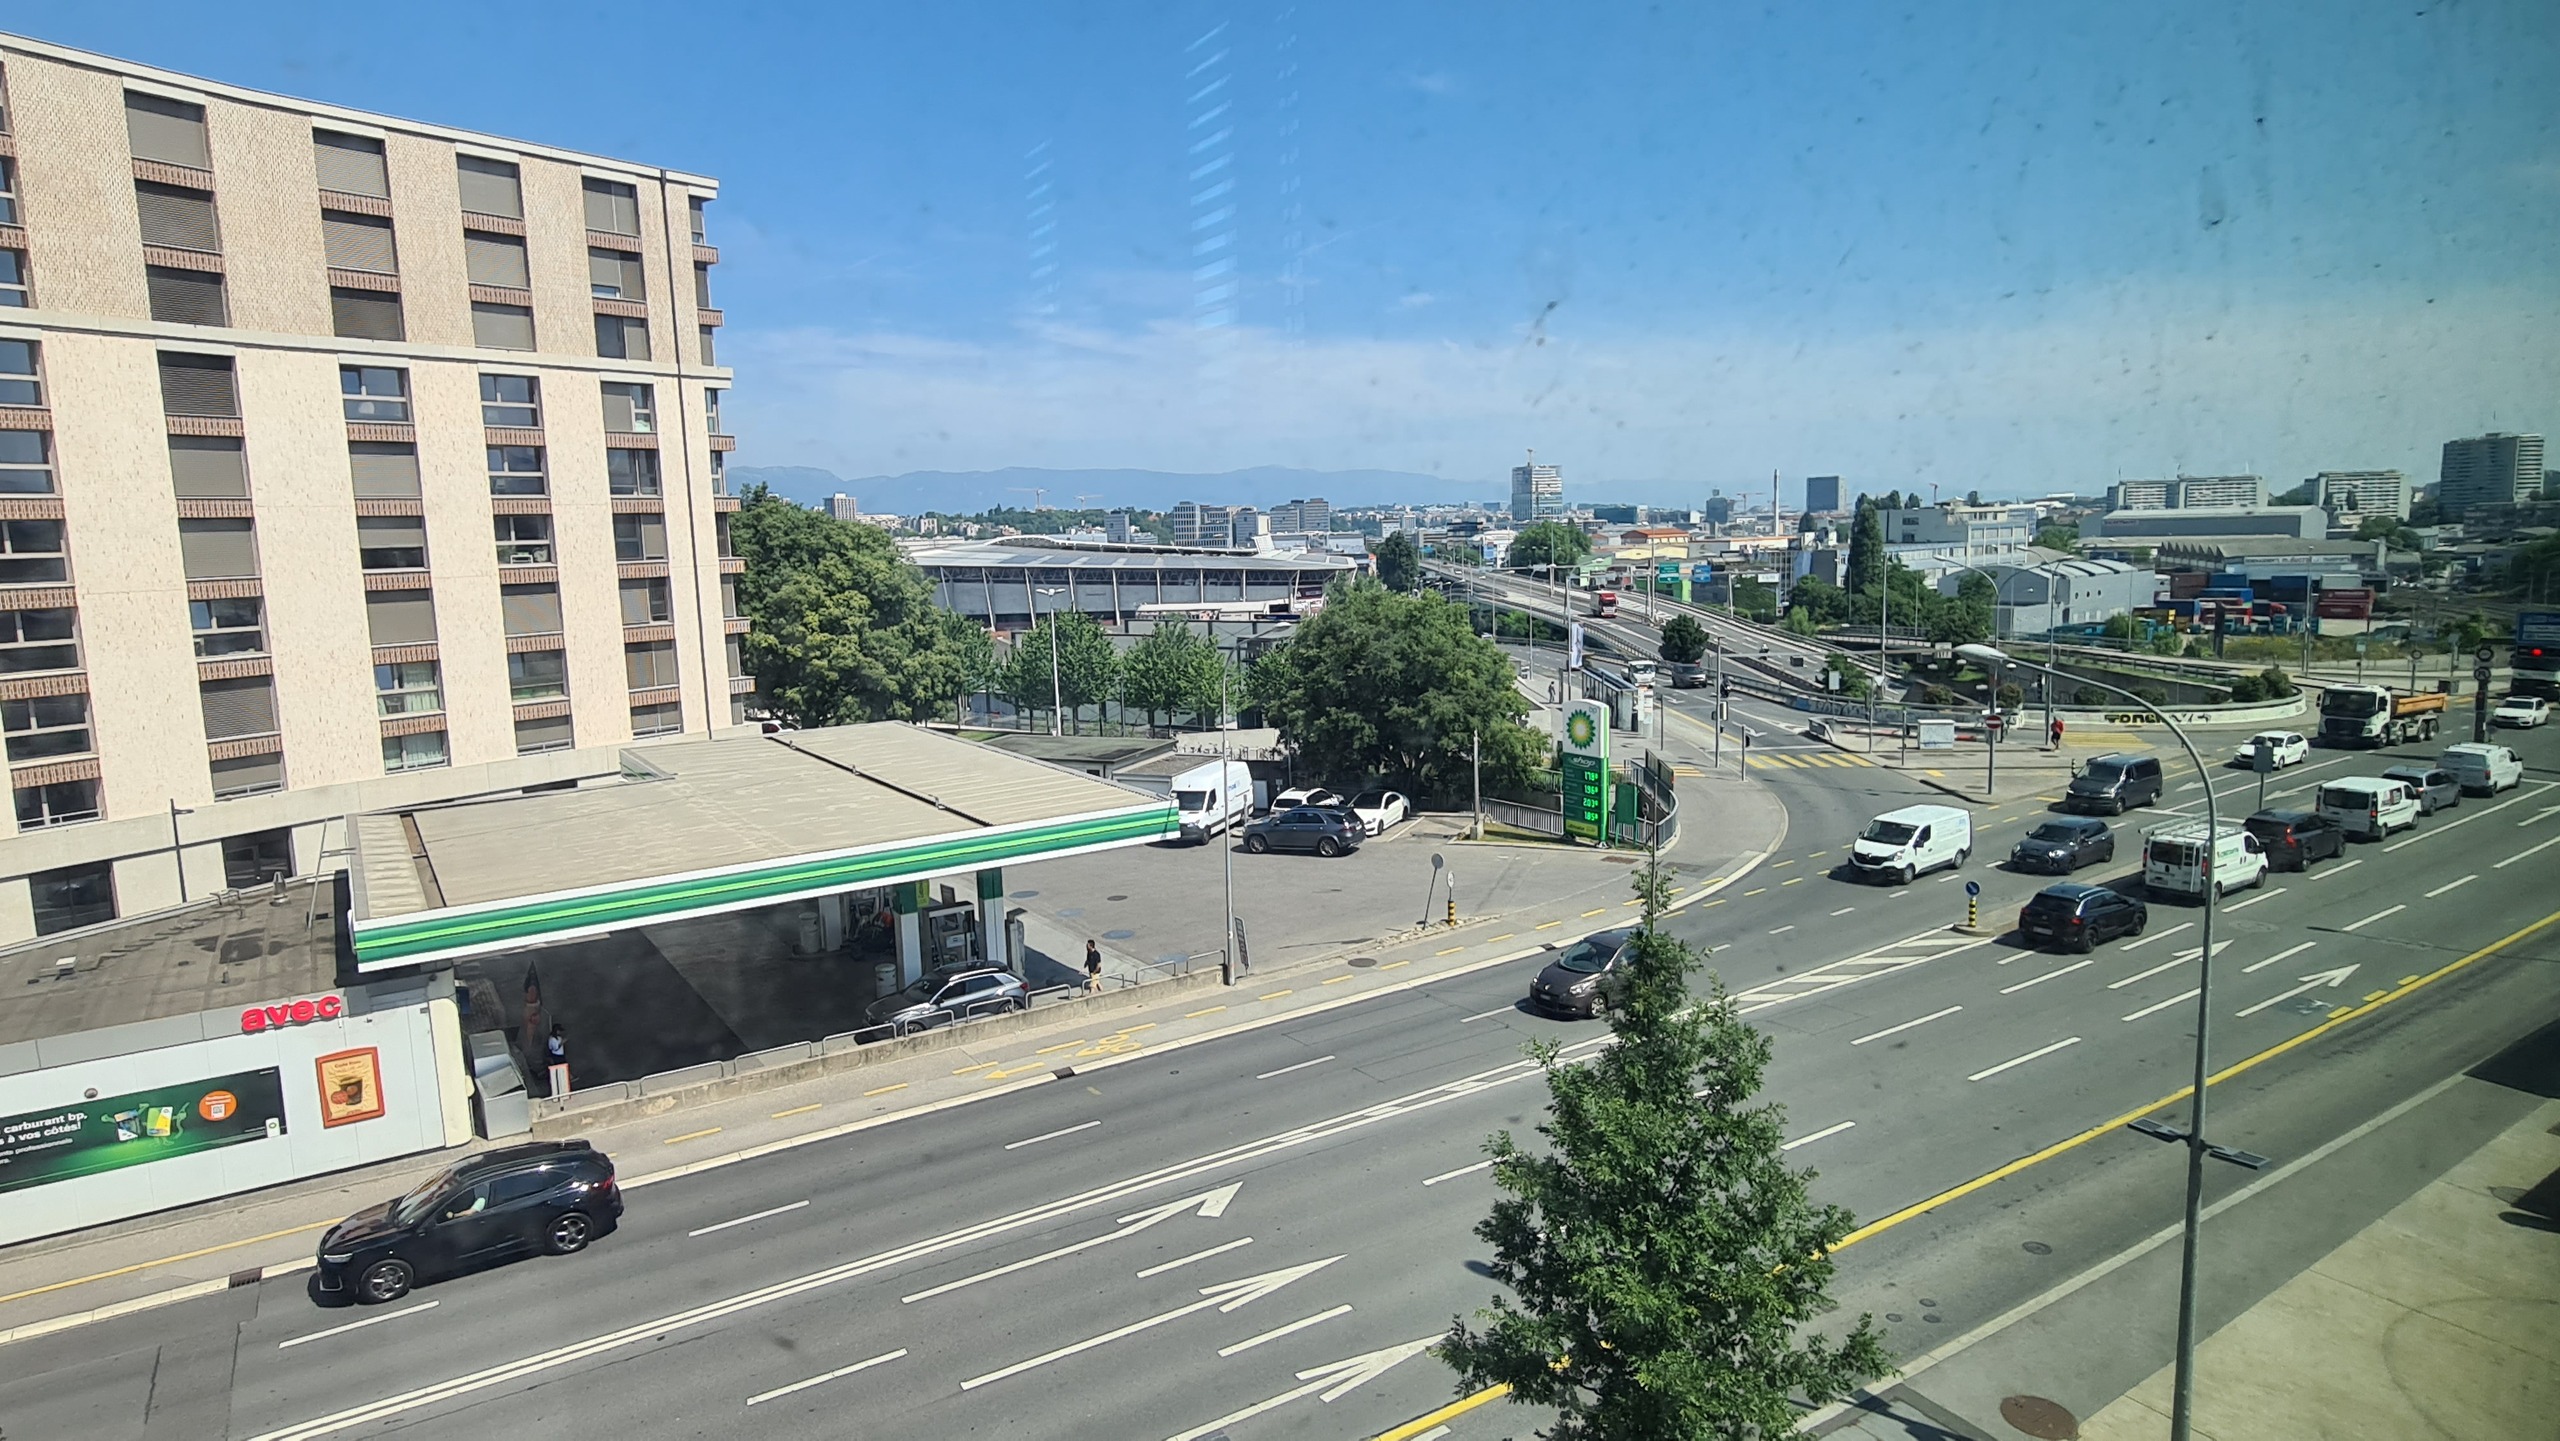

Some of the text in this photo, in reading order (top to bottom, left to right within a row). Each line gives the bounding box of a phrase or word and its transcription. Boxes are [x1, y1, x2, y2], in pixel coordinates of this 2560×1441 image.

[1573, 757, 1595, 767] shop
[242, 995, 342, 1032] avec
[4, 1115, 65, 1133] carburant
[18, 1131, 42, 1141] vos
